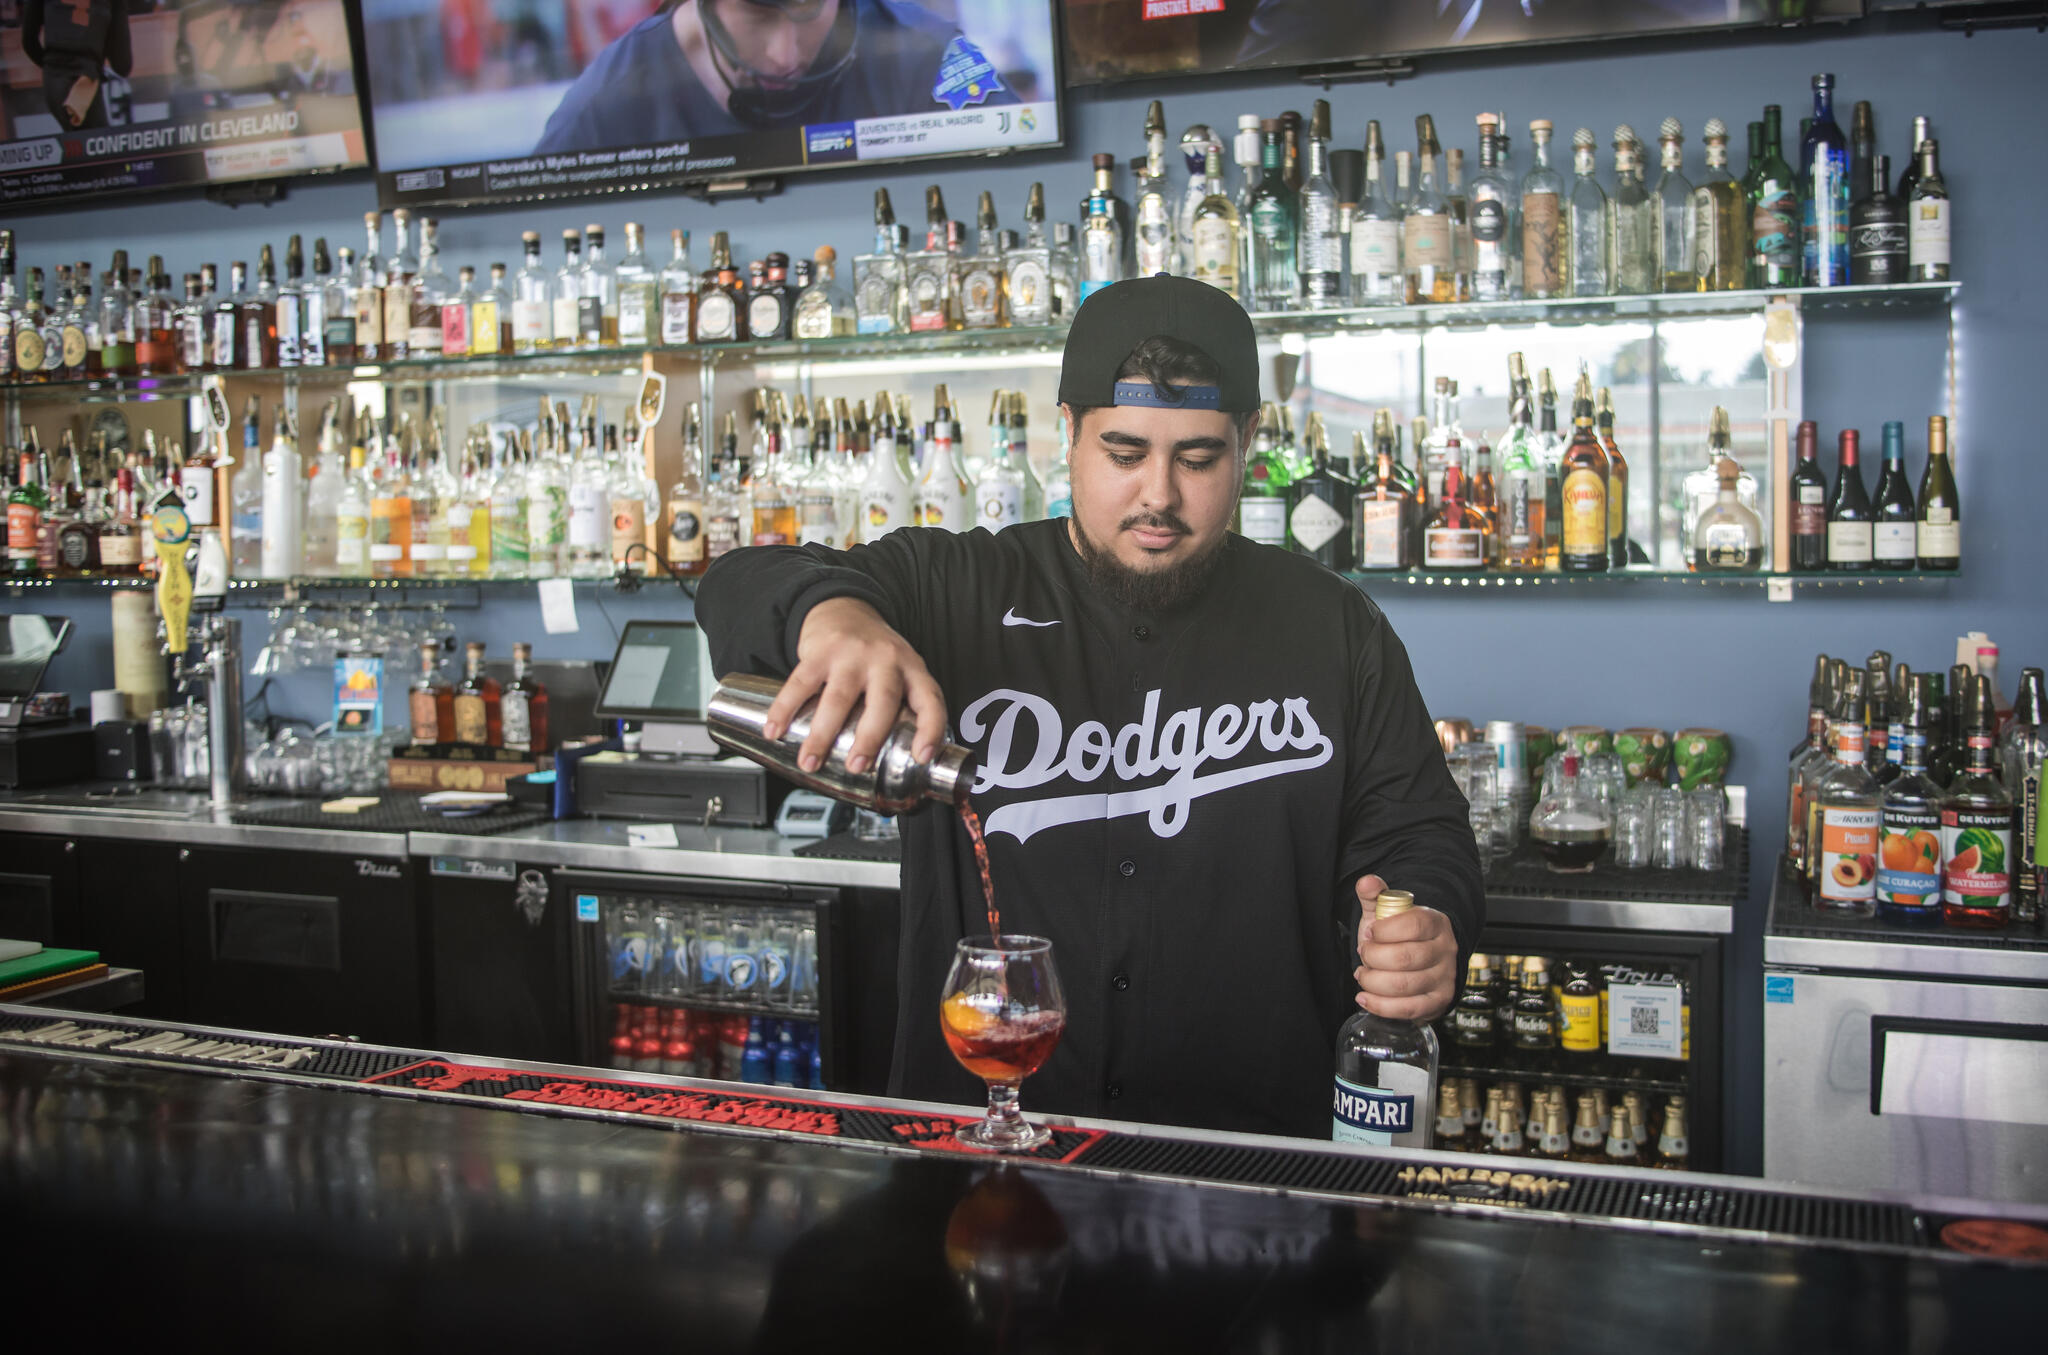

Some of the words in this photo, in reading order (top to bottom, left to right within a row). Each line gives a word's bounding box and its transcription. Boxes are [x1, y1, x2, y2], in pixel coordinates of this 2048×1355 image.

[86, 126, 176, 156] CONFIDENT
[179, 124, 197, 144] IN
[200, 111, 299, 142] CLEVELAND
[859, 121, 906, 136] JUVENTUS
[919, 117, 944, 129] REAL
[946, 114, 984, 127] MADRID
[34, 144, 54, 161] UP
[488, 159, 545, 175] Nebraska's
[546, 156, 577, 171] Myles
[618, 148, 654, 162] enters
[655, 142, 690, 161] portal
[569, 167, 618, 182] suspended
[635, 163, 650, 174] for
[650, 161, 673, 174] start
[675, 159, 685, 171] of
[686, 156, 736, 172] preseason
[960, 688, 1326, 839] Dodgers
[1884, 812, 1895, 822] DE
[1896, 813, 1938, 824] KUYPER
[1959, 814, 1973, 824] DE
[1891, 877, 1936, 889] CURAÇAO
[1948, 876, 2008, 890] WATERMELON
[1456, 1013, 1488, 1028] Modelo
[1515, 1016, 1548, 1031] Modelo
[1333, 1087, 1408, 1126] AMPARI
